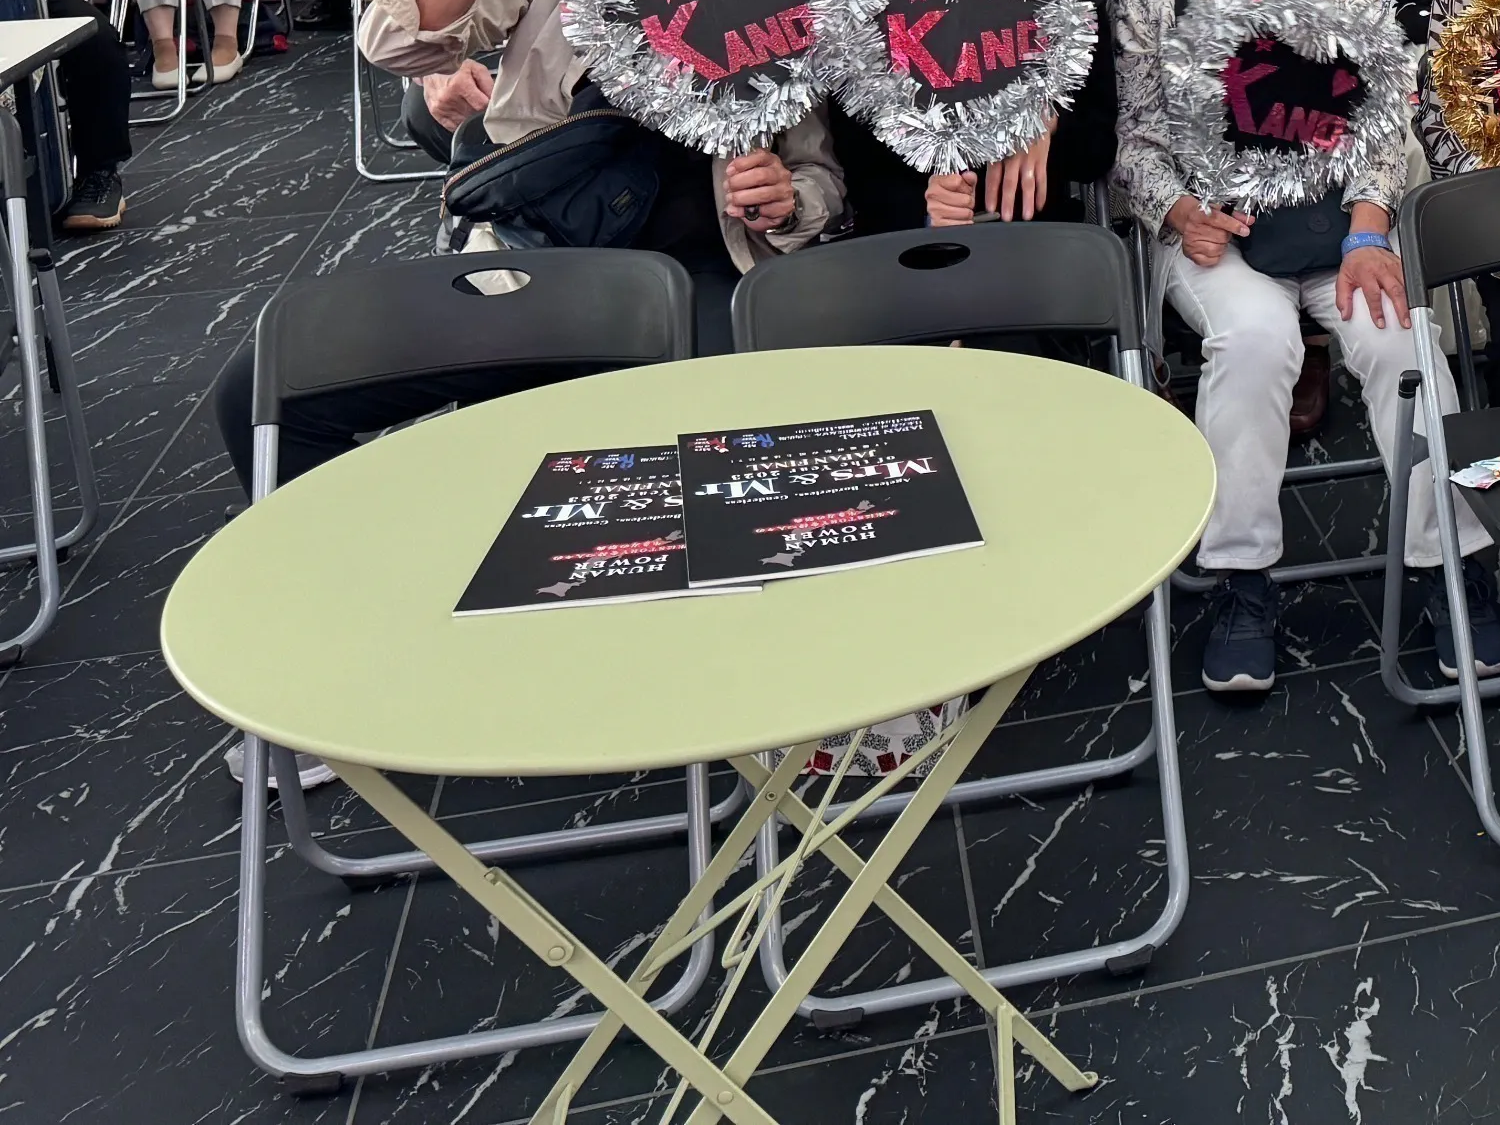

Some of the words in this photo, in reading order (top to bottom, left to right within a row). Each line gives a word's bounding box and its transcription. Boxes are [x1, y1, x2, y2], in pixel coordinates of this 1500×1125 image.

[814, 450, 877, 463] JAPAN
[876, 455, 895, 463] of
[747, 458, 809, 471] FINAL
[789, 464, 828, 473] Year
[832, 456, 937, 482] Mrs
[732, 470, 780, 480] 2023
[789, 473, 820, 485] &
[590, 481, 650, 493] FINAL
[628, 489, 670, 498] Year
[694, 477, 780, 498] Mr
[569, 493, 619, 503] 2023
[619, 498, 653, 510] &
[521, 501, 613, 522] Mr
[781, 522, 874, 541] POWER
[785, 531, 876, 550] HUMAN
[575, 554, 669, 570] POWER
[569, 563, 665, 580] HUMAN
